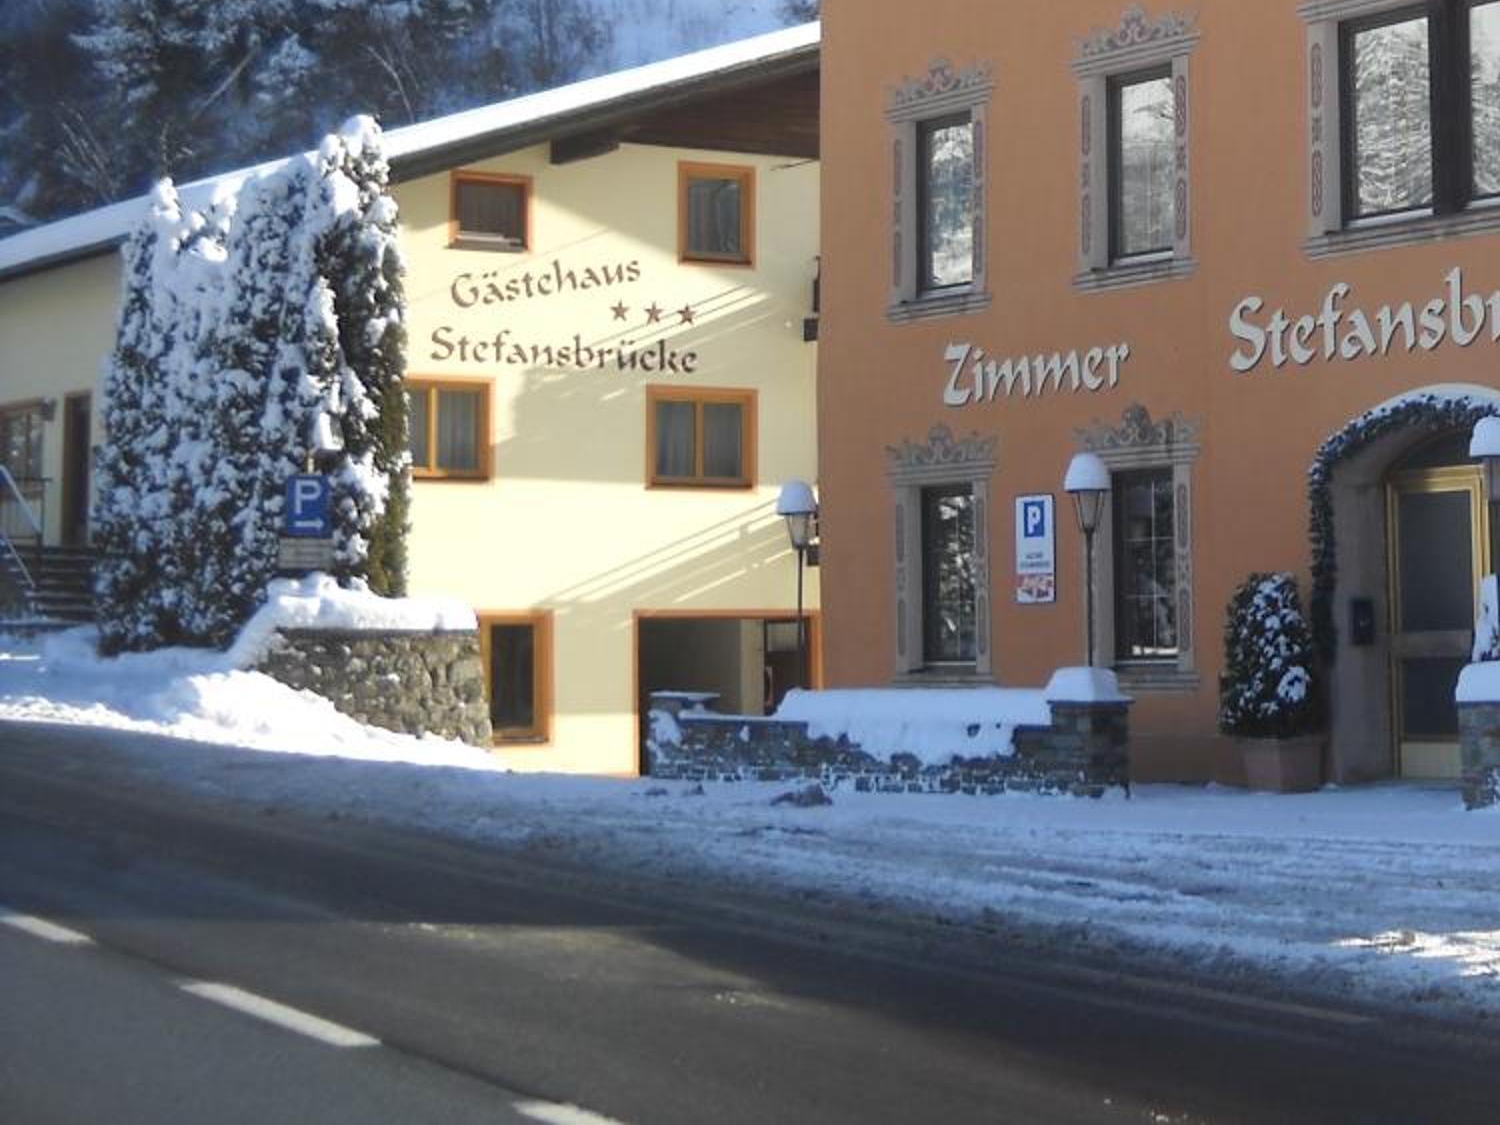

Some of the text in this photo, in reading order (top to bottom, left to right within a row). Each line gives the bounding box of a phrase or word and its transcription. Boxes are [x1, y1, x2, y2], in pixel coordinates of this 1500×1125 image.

[450, 258, 642, 309] Gästehaus
[430, 325, 698, 374] Stefansbrücke
[943, 341, 1129, 406] Zimmer
[294, 479, 322, 515] P
[1027, 506, 1041, 534] P
